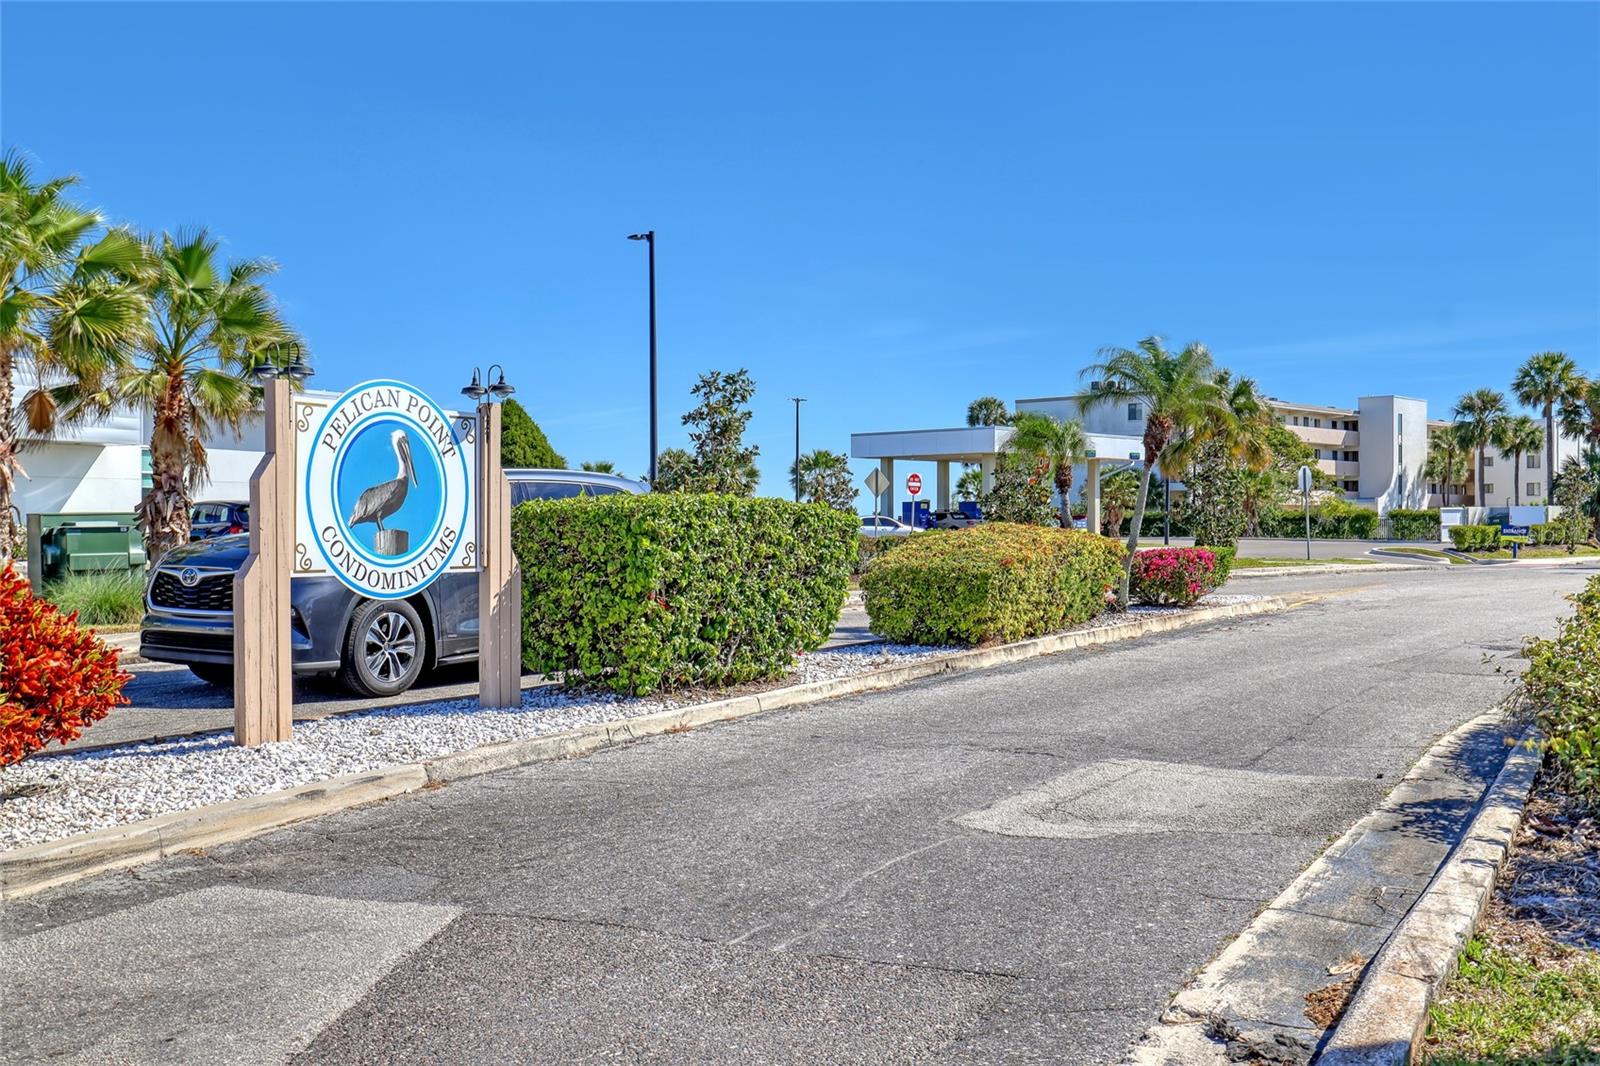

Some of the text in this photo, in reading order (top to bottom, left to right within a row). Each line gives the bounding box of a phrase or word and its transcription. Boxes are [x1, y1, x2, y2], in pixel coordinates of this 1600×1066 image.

[322, 389, 456, 458] PELICAN POINT
[322, 526, 456, 590] CONDOMINIUMS
